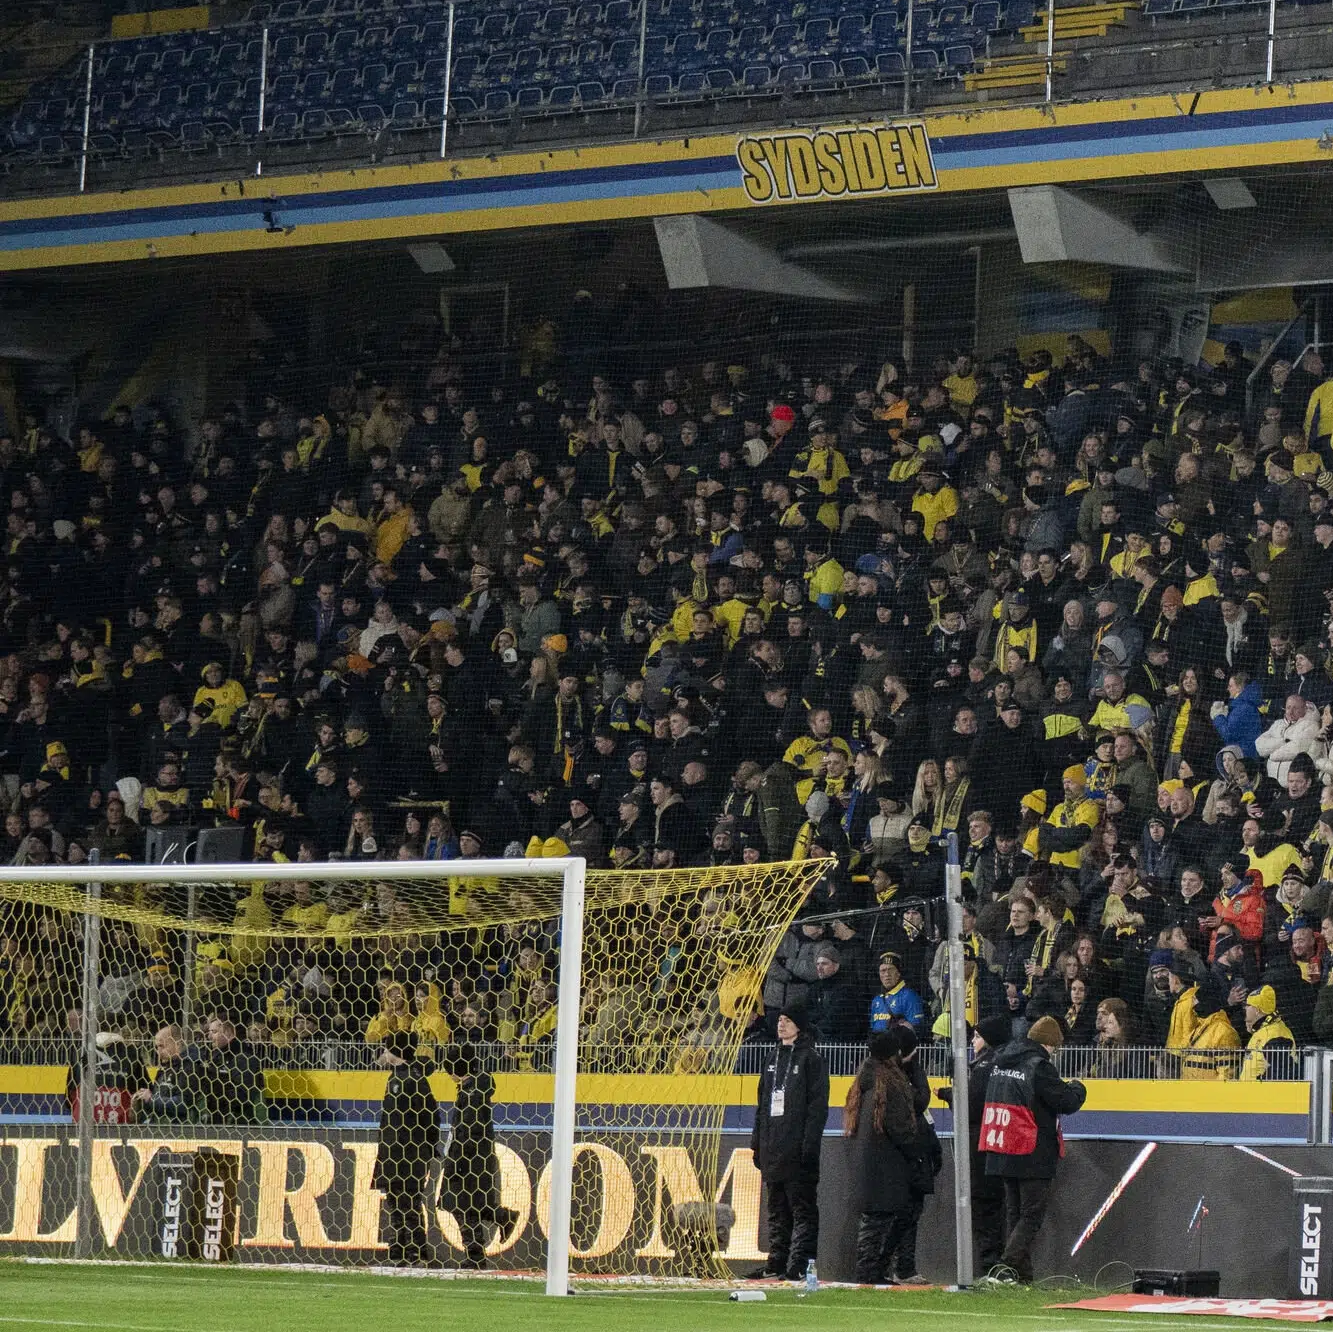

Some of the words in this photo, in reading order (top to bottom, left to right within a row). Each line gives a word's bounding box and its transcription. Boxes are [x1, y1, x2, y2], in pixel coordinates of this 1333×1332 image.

[741, 124, 937, 202] SYDSIDEN
[161, 1176, 182, 1259] SELECT
[203, 1178, 225, 1261] SELECT
[1299, 1203, 1322, 1296] SELECT
